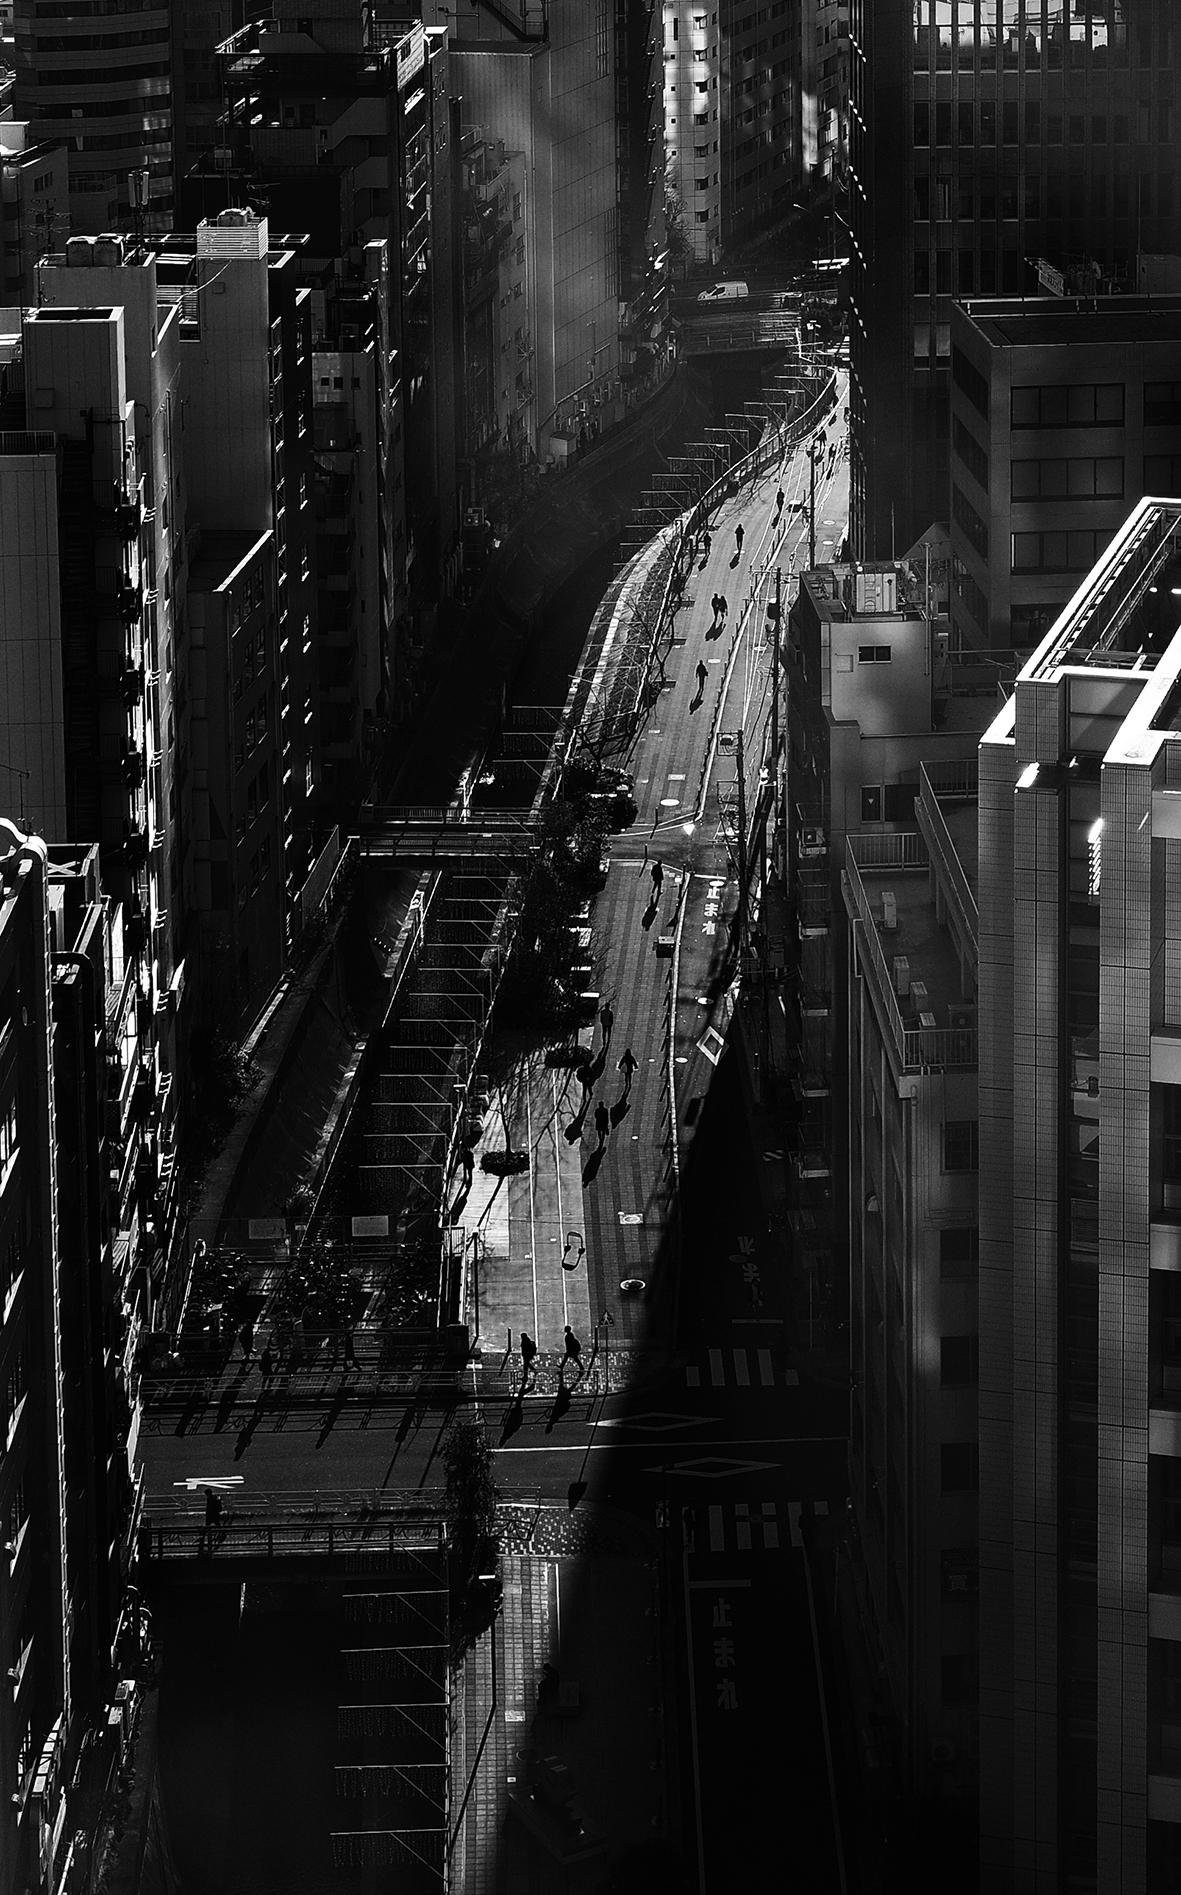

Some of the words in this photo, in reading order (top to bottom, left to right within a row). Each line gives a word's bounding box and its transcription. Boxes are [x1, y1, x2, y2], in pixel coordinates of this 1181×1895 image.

[702, 886, 720, 935] 止まれ
[737, 1236, 763, 1306] まれ
[712, 1597, 739, 1711] 止まれ
